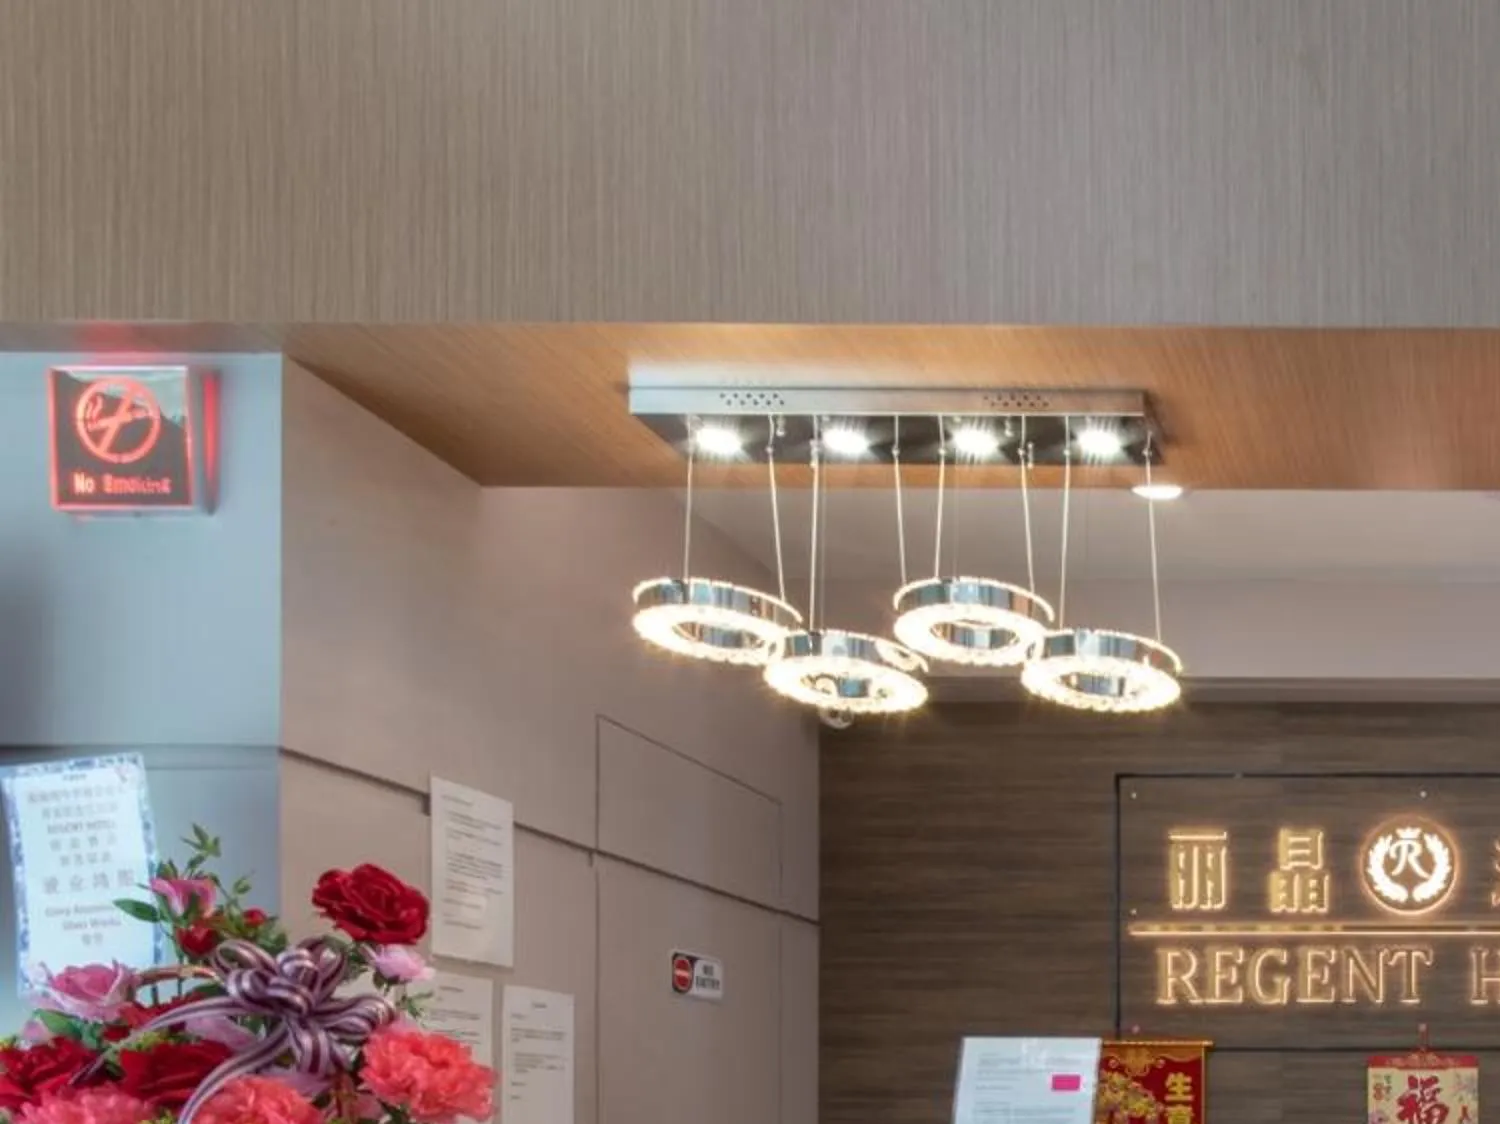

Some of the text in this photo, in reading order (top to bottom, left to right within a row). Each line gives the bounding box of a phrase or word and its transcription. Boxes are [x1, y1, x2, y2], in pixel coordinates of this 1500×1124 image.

[73, 471, 95, 493] No
[1168, 828, 1330, 913] 丽晶
[1156, 948, 1433, 1005] REGENT
